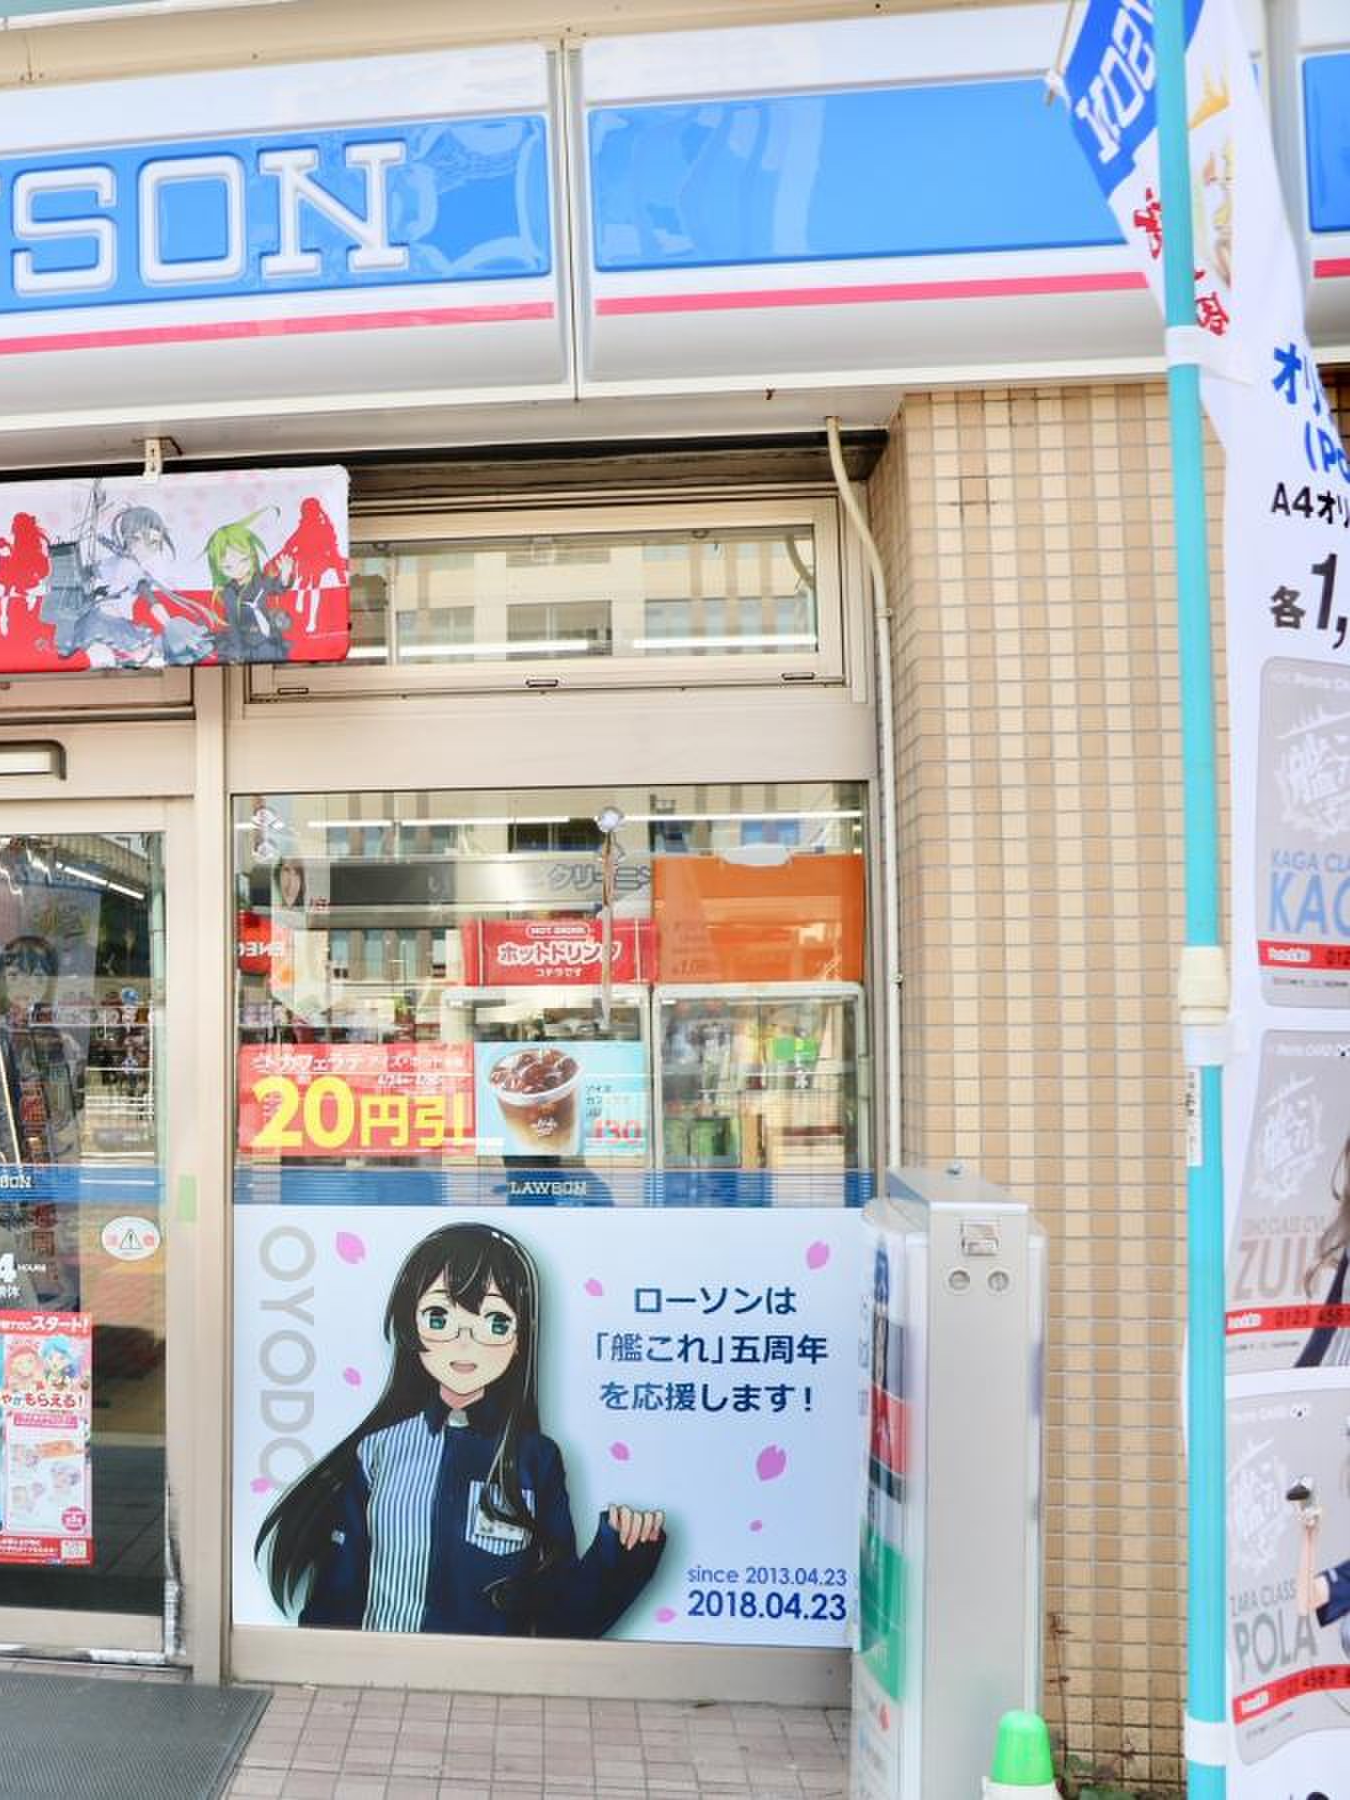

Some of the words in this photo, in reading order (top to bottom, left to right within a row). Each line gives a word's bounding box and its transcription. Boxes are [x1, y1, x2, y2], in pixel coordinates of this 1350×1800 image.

[250, 1075, 466, 1149] 20円引
[509, 1181, 588, 1196] LAWSON
[634, 1285, 798, 1317] ローソンは
[595, 1333, 830, 1367] 「艦これ」五周年
[687, 1564, 740, 1585] since
[744, 1565, 847, 1588] 2013.04.23
[687, 1589, 848, 1623] 2018.04.23
[1233, 1612, 1319, 1682] POLA
